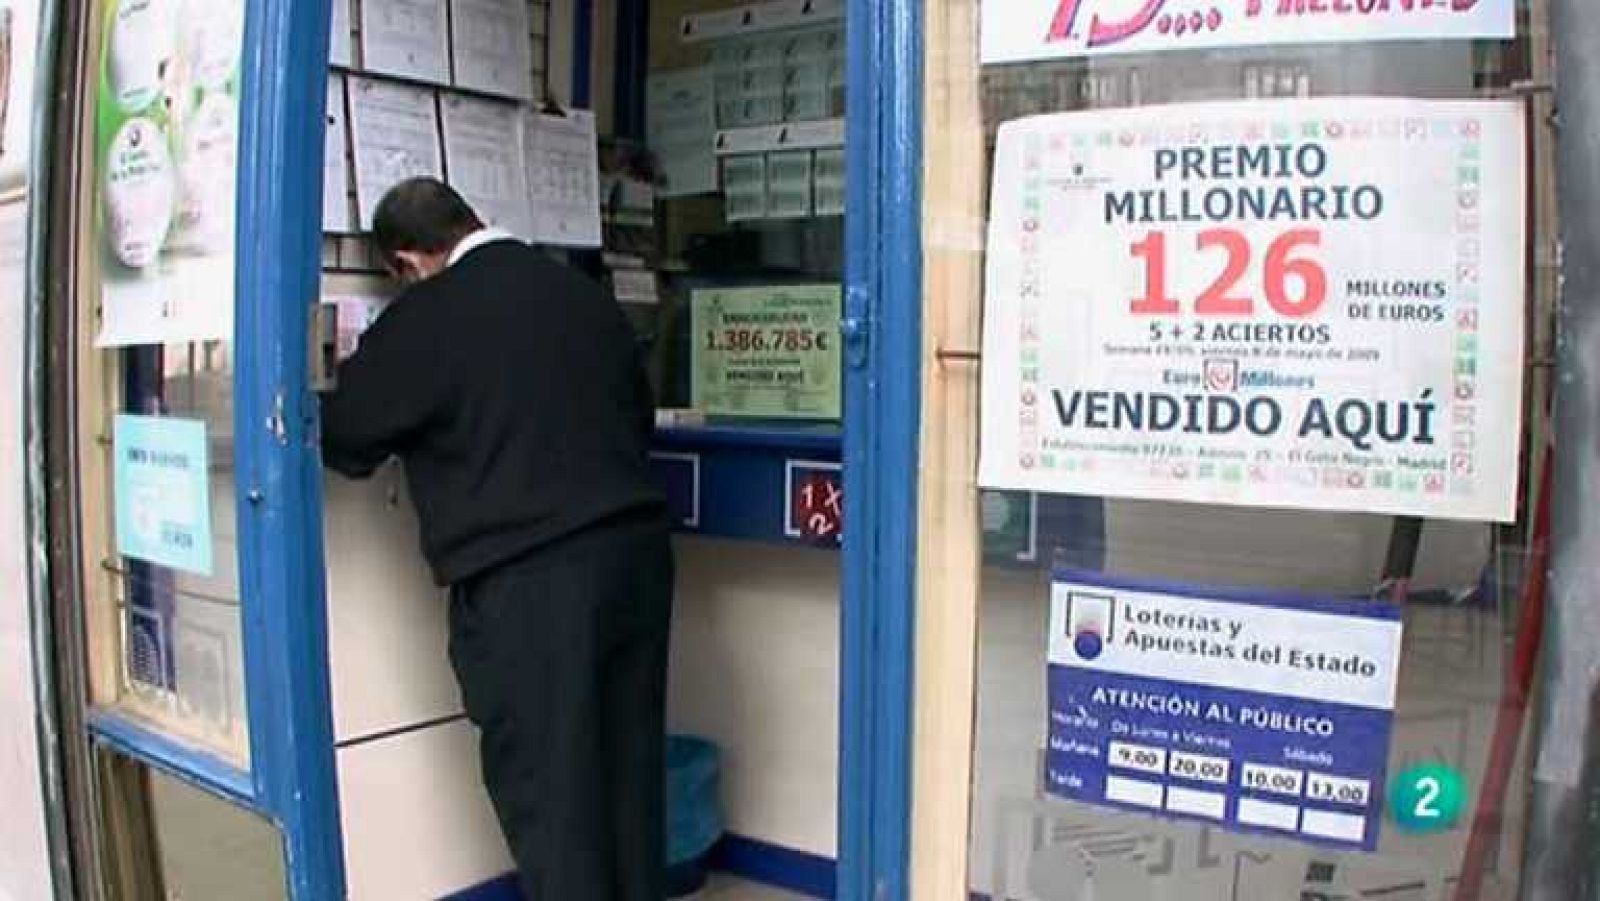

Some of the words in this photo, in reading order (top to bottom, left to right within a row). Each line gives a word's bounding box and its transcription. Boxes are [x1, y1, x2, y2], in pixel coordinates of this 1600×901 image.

[1153, 143, 1327, 180] PREMIO
[1104, 185, 1384, 224] MILLONARIO
[1129, 227, 1328, 318] 126
[1346, 278, 1447, 299] MILLONES
[1348, 302, 1374, 322] DE
[1378, 302, 1446, 323] EUROS
[1149, 323, 1163, 341] 5
[1171, 326, 1184, 340] +
[1193, 323, 1205, 342] 2
[1212, 323, 1331, 344] ACIERTOS
[1163, 369, 1200, 386] Euro
[1240, 369, 1316, 389] Millones
[1052, 389, 1283, 436] VENDIDO
[1298, 387, 1437, 450] AQUÍ
[801, 484, 814, 509] 1
[1123, 603, 1221, 635] Loterías
[1228, 619, 1243, 640] y
[1123, 627, 1236, 663] Apuestas
[1242, 642, 1281, 666] del
[1288, 650, 1378, 679] Estado
[1091, 685, 1200, 718] ATENCIÓN
[1205, 702, 1234, 724] AL
[1240, 705, 1335, 737] PÚBLICO
[1111, 719, 1129, 734] De
